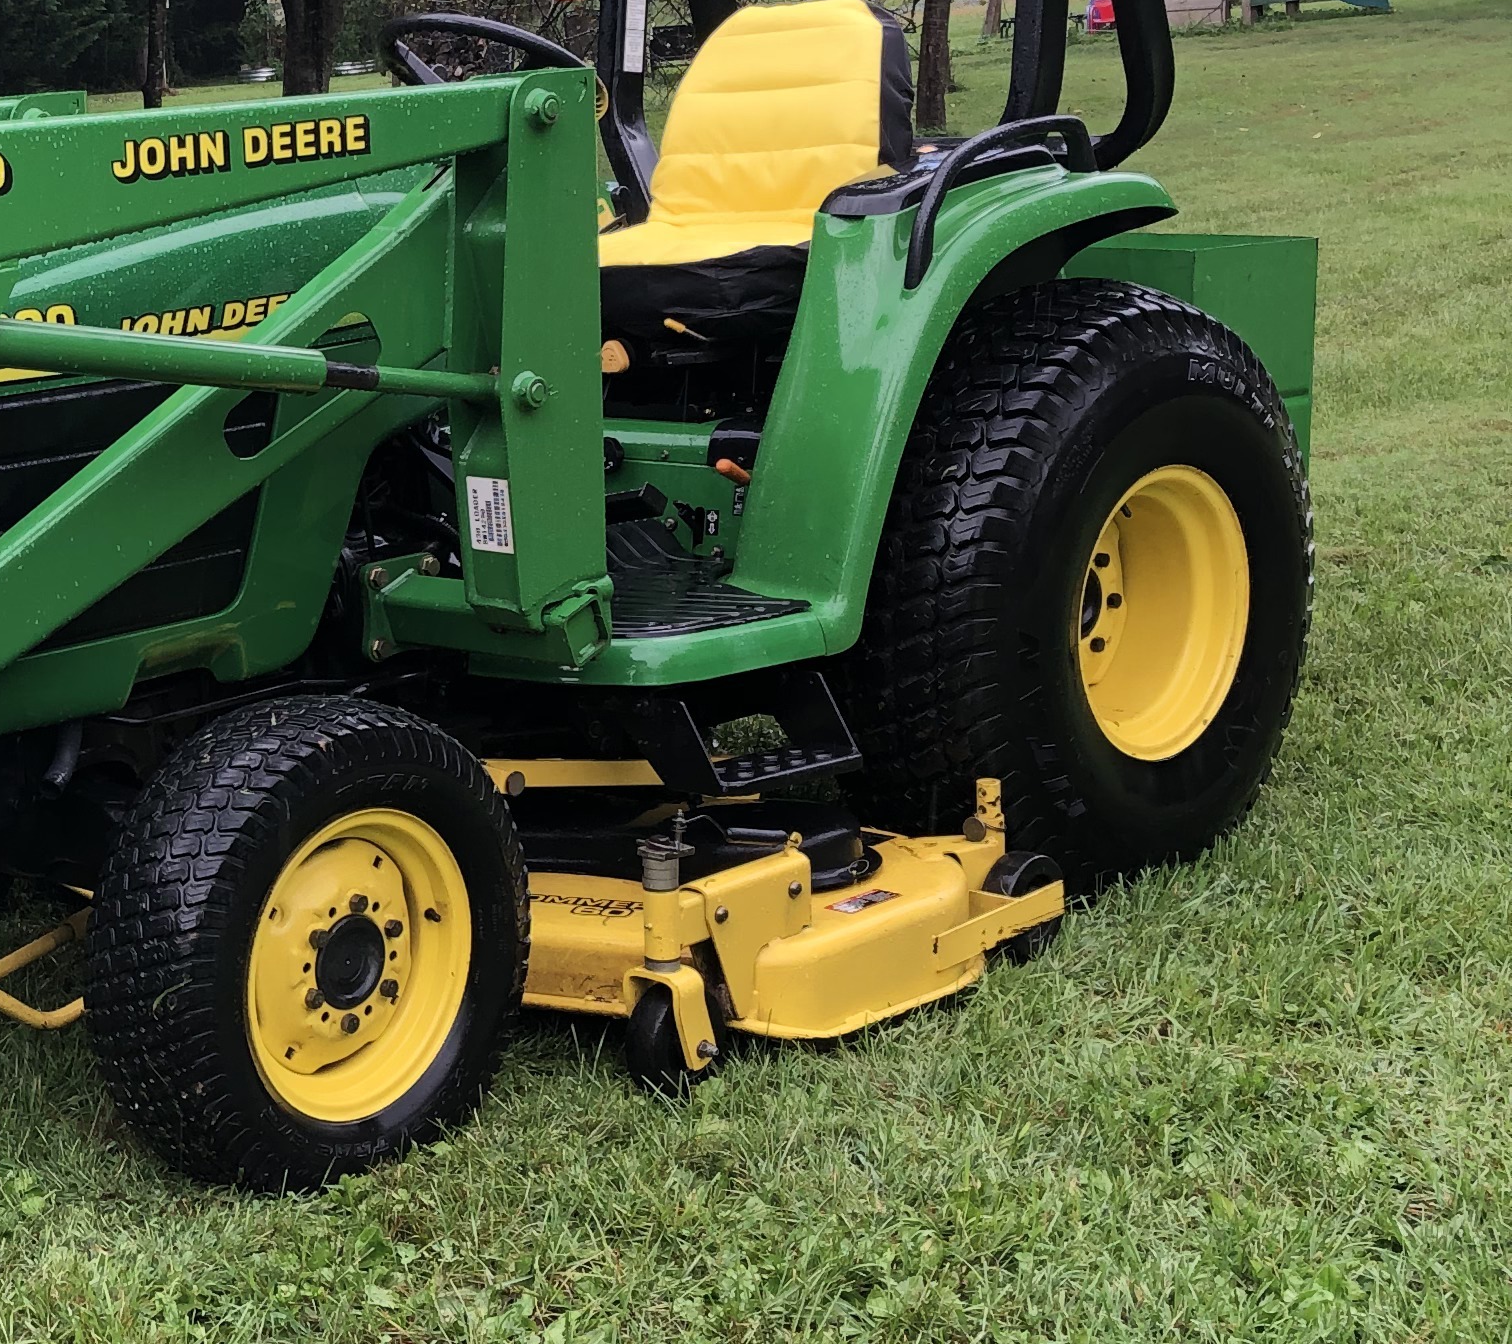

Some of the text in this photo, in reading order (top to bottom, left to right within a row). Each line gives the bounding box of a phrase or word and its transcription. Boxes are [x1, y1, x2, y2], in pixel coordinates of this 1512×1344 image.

[112, 114, 370, 184] JOHN DEERE
[472, 488, 480, 522] LOADER
[570, 906, 635, 917] 60
